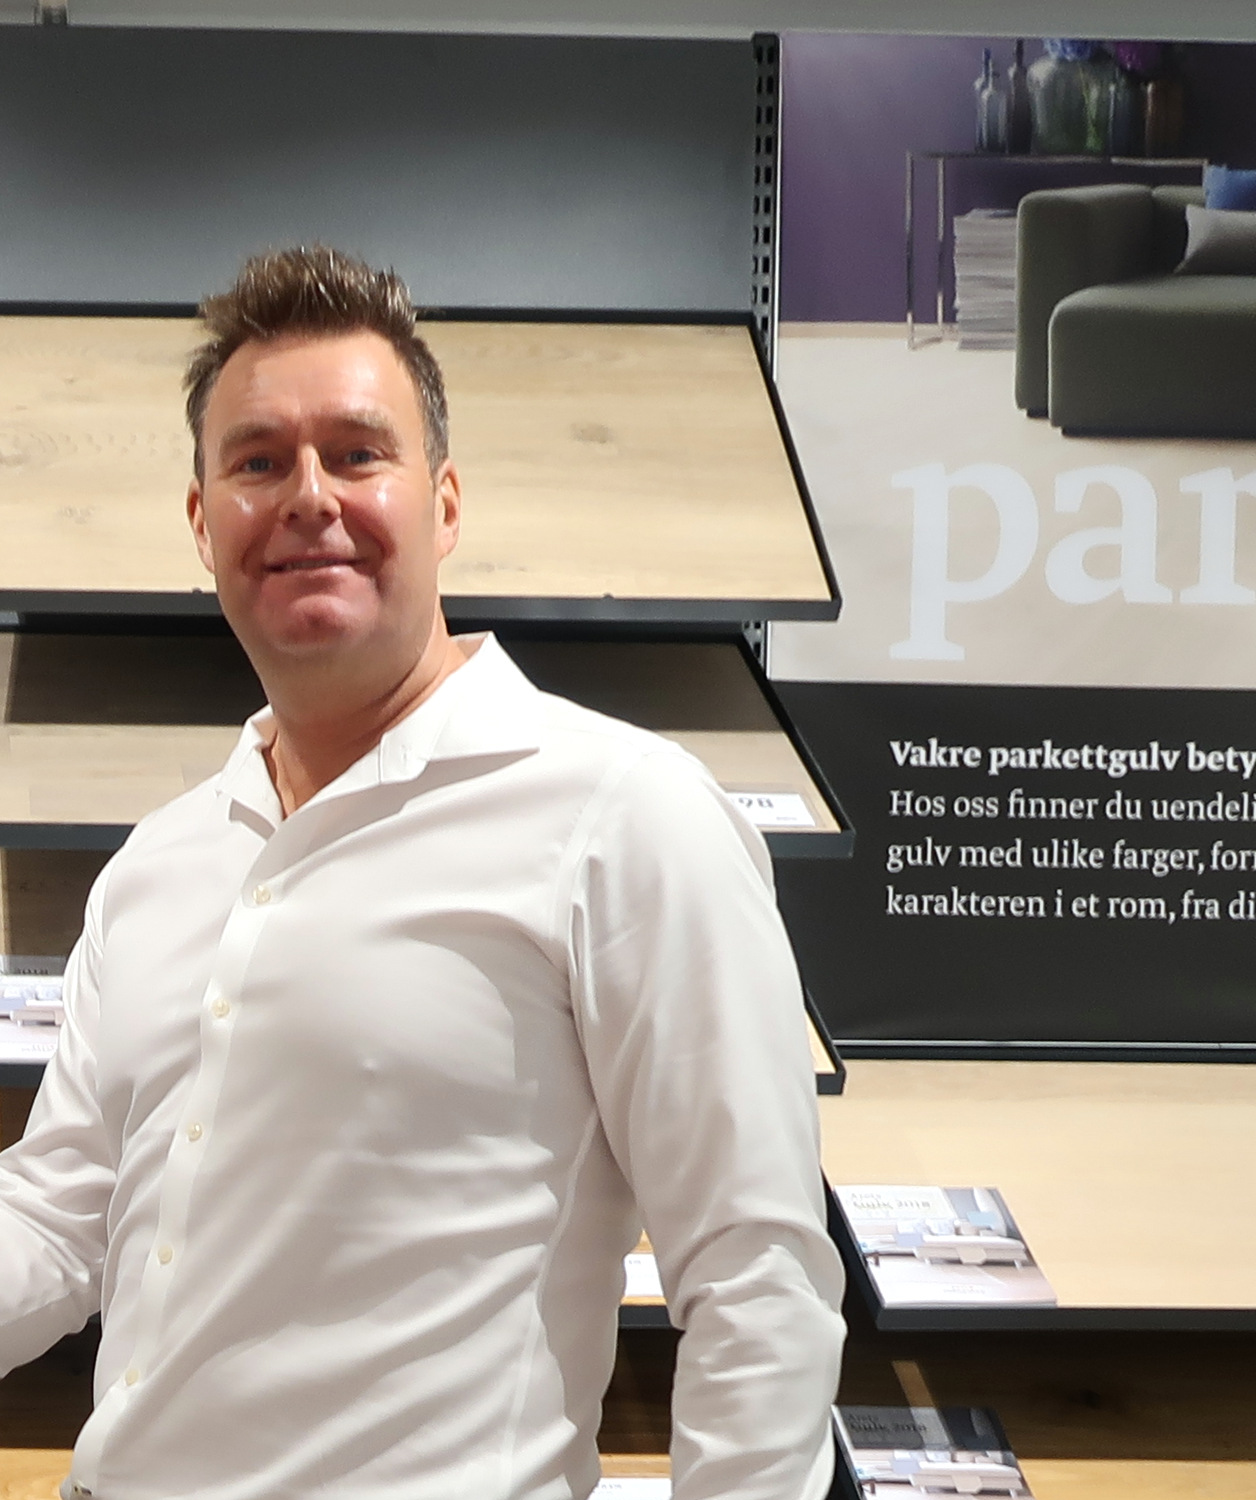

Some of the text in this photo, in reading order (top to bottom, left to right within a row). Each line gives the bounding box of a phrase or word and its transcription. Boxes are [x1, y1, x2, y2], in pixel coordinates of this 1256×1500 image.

[889, 737, 981, 768] Vakre
[988, 739, 1181, 778] parkettgulv
[889, 790, 945, 816] Hos
[953, 794, 999, 817] oss
[1008, 789, 1098, 819] finner
[1105, 791, 1143, 821] du
[886, 838, 951, 872] gulv
[959, 839, 1022, 868] med
[1031, 839, 1104, 869] ulike
[1112, 840, 1205, 876] farger,
[886, 886, 1044, 918] karakteren
[1054, 889, 1063, 917] i
[1071, 892, 1100, 918] et
[1107, 894, 1177, 923] rom,
[1181, 890, 1220, 920] fra
